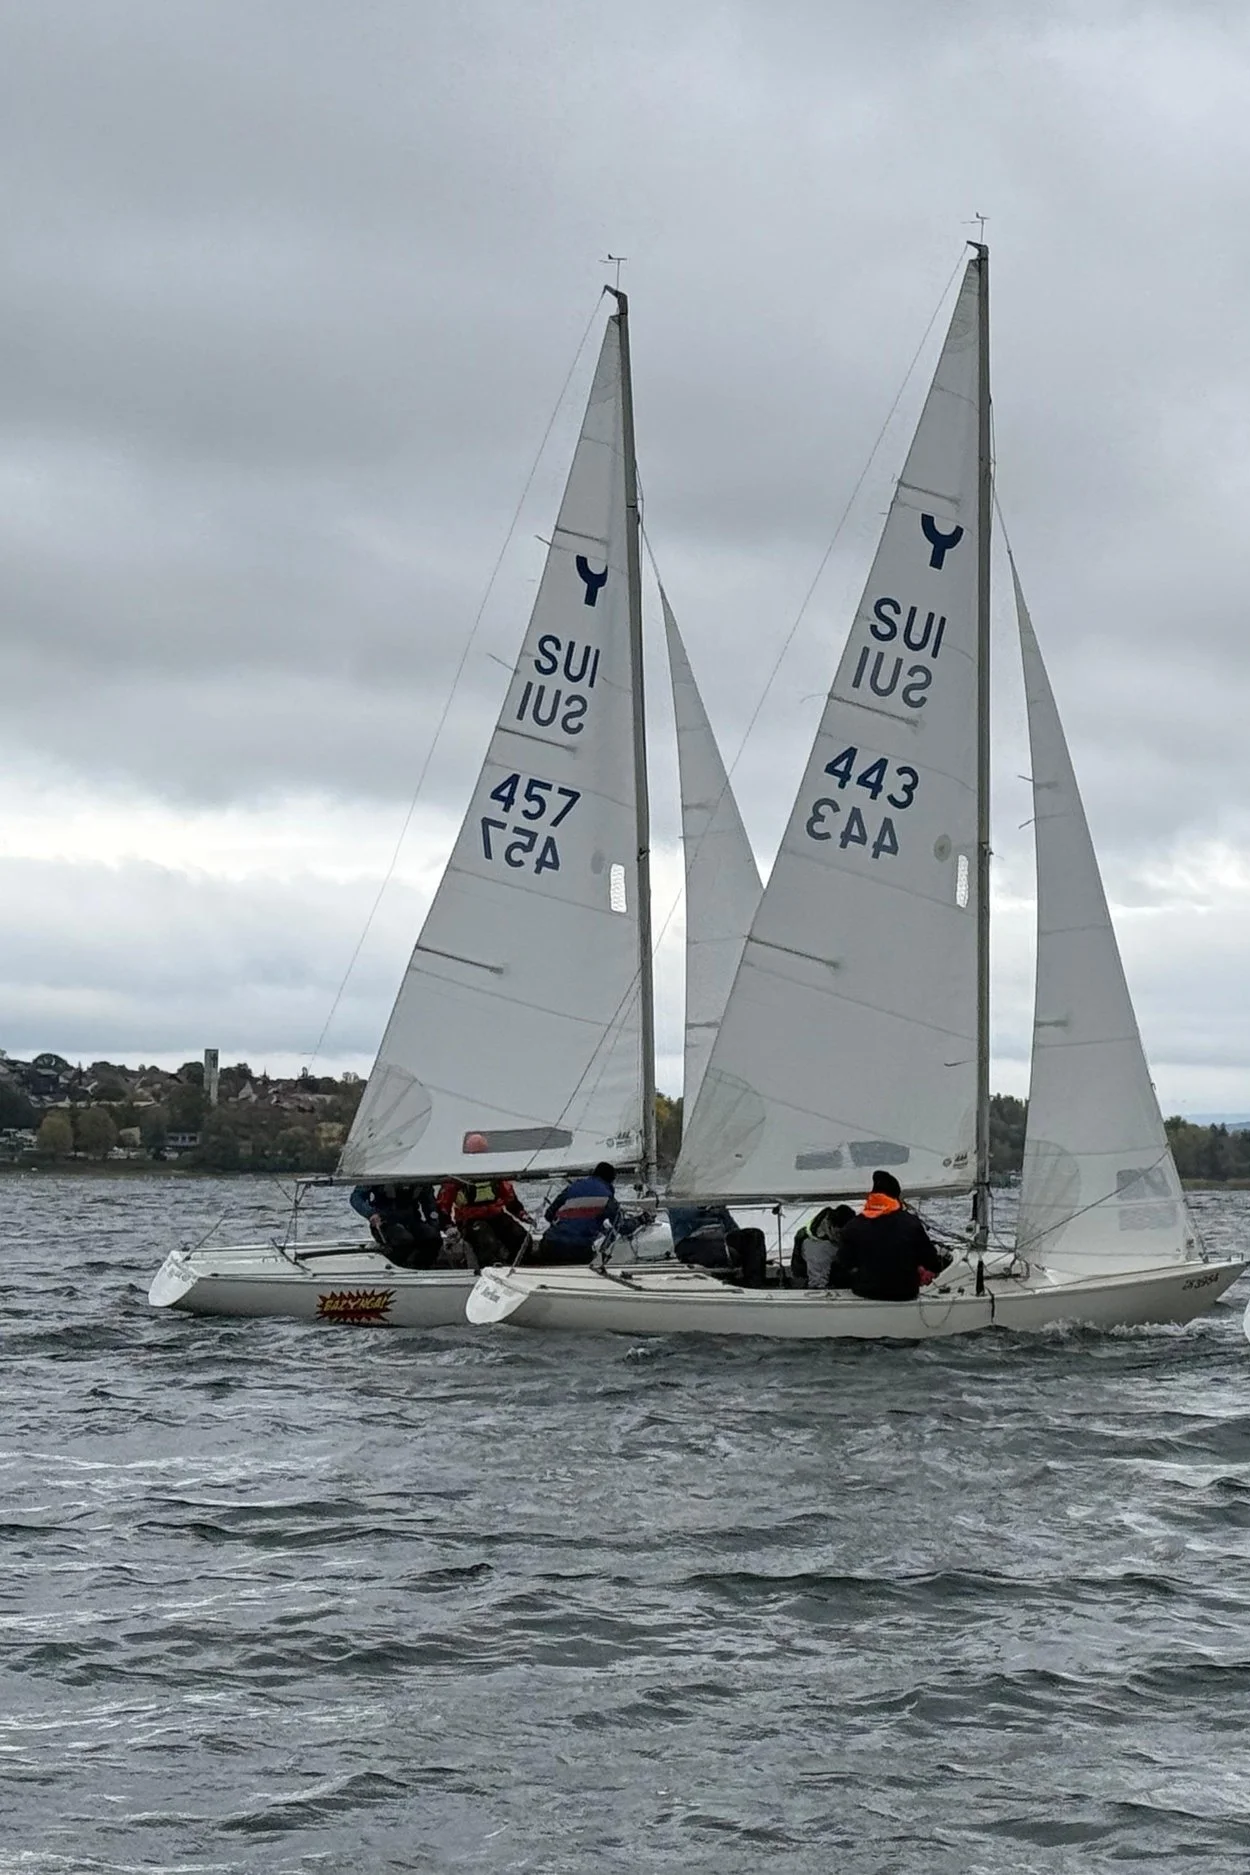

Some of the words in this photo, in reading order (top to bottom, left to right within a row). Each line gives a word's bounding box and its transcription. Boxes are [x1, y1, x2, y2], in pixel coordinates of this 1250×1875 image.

[870, 598, 946, 659] SUI
[534, 635, 600, 688] SUI
[490, 773, 581, 827] 457
[824, 747, 918, 808] 443
